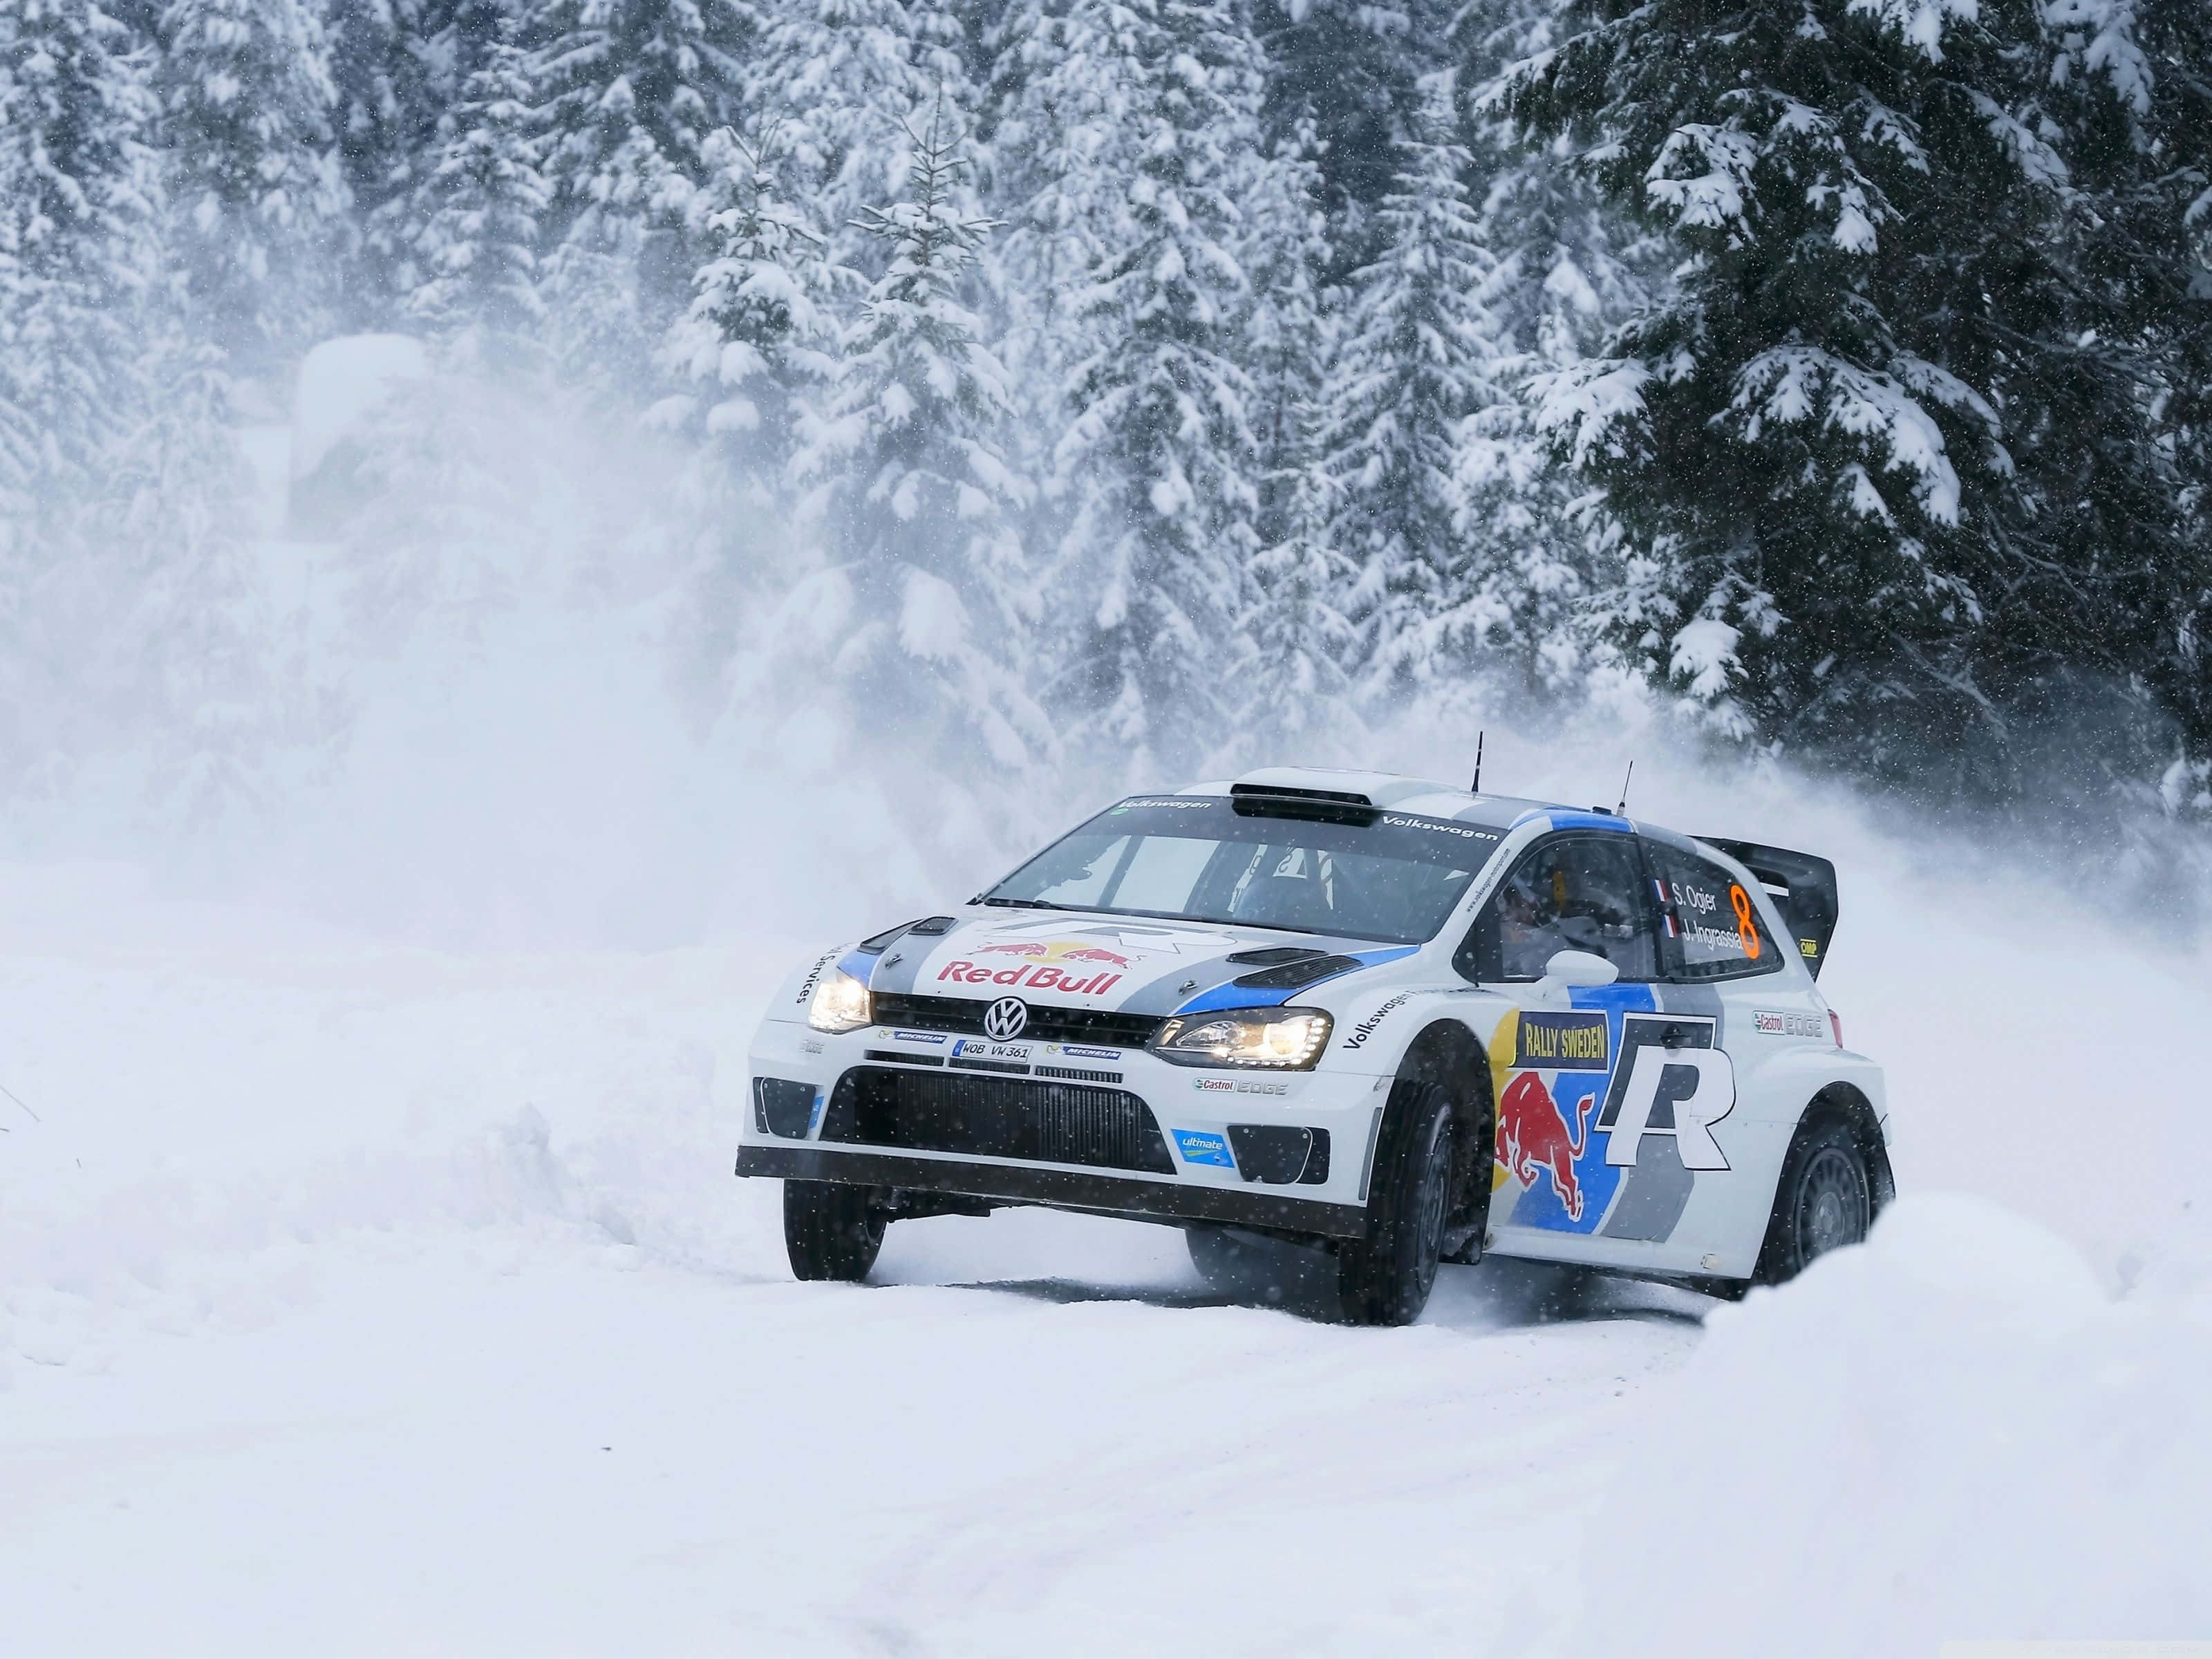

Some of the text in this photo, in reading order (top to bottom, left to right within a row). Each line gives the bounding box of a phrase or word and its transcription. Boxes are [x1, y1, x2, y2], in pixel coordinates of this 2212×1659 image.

[1118, 799, 1212, 809] Volkswagen
[1382, 816, 1499, 841] Volkswagen
[1671, 883, 1716, 915] S. Ogier
[1730, 884, 1761, 959] 8
[1682, 919, 1744, 952] J. Ingrassia
[1801, 941, 1817, 955] OMP
[796, 955, 835, 1004] Services
[937, 961, 1123, 995] Red Bull
[1343, 991, 1412, 1050] Volkswagen
[1761, 1013, 1823, 1038] Castrol EDGE
[897, 1031, 946, 1042] MICHELIN
[1526, 1022, 1604, 1058] RALLY SWEDEN
[963, 1042, 1028, 1058] WOB VW 361
[1067, 1047, 1120, 1058] MICHELIN
[1203, 1080, 1288, 1095] Castrol EDGE
[1606, 1045, 1736, 1170] R
[1182, 1137, 1223, 1150] ultimate
